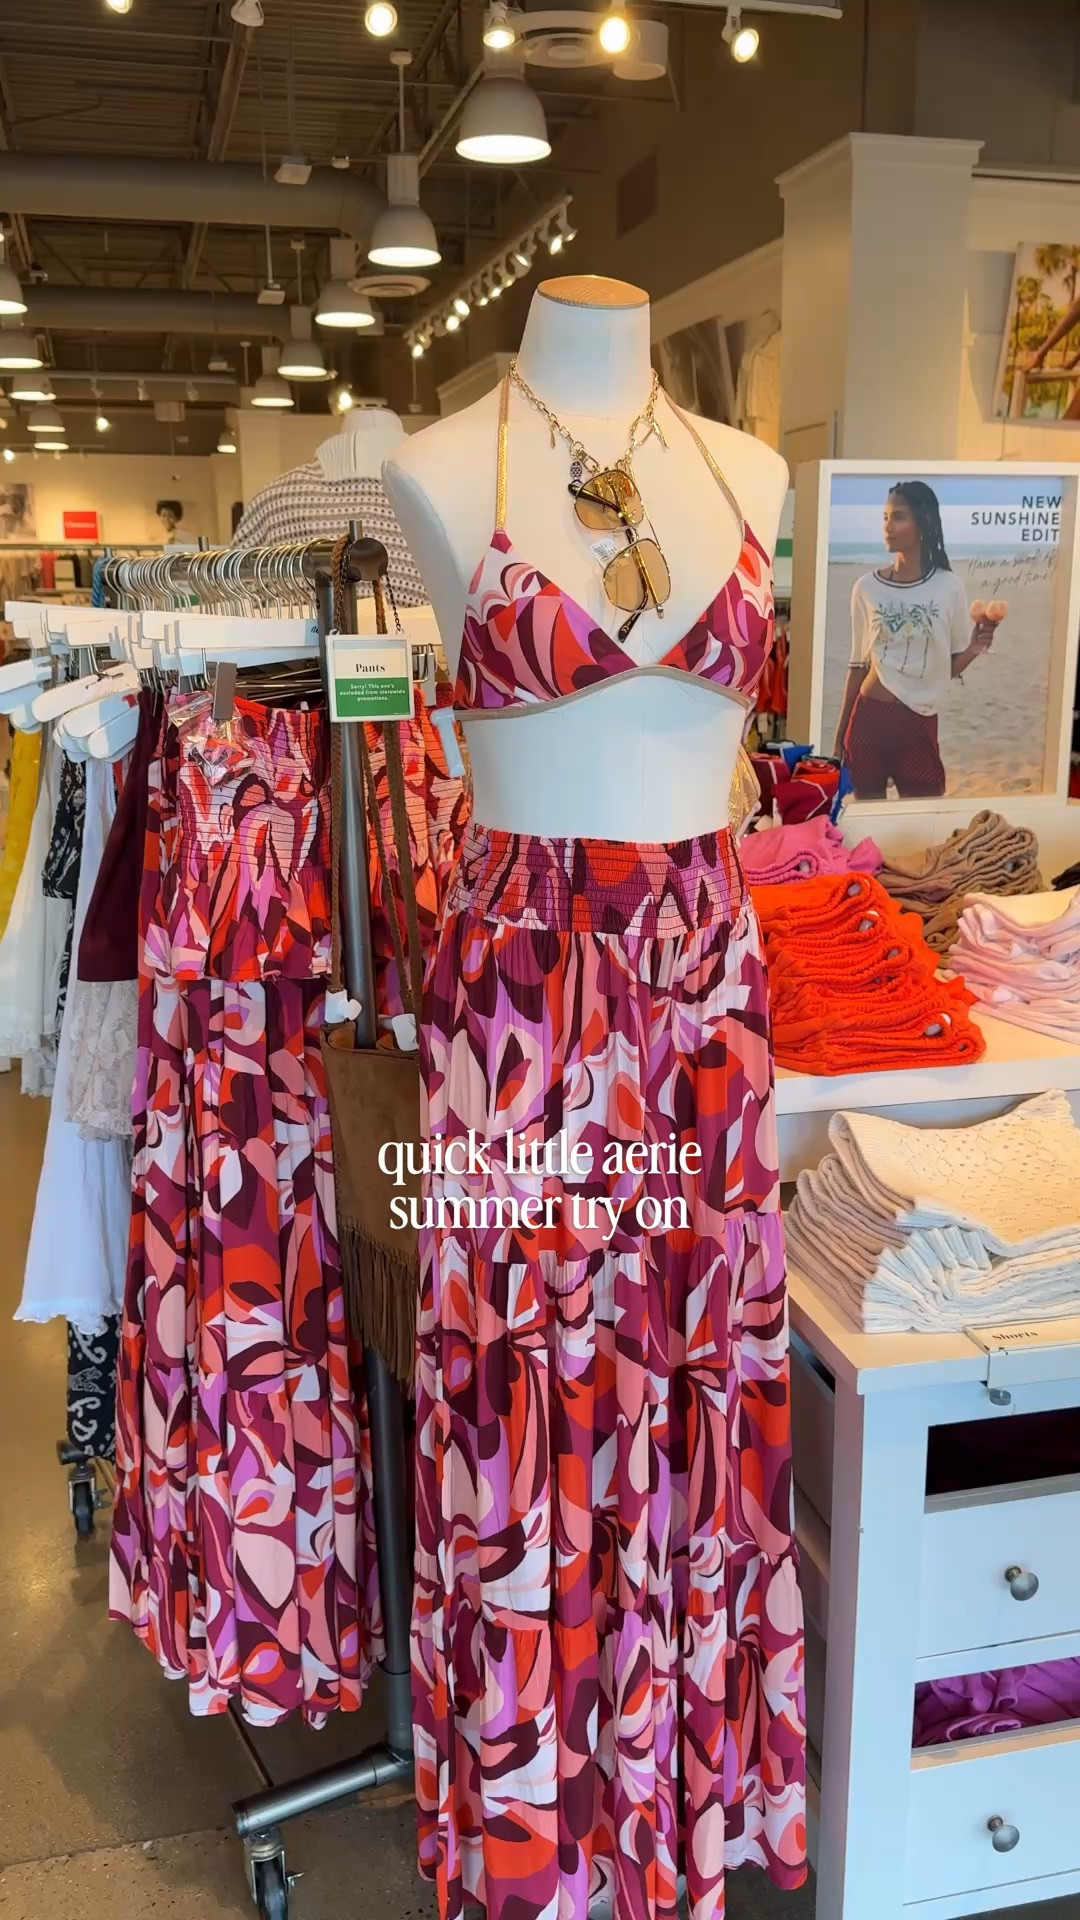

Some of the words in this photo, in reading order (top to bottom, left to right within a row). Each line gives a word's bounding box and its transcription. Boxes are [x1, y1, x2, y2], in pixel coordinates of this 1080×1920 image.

[1021, 496, 1062, 509] NEW
[971, 512, 1060, 525] SUNSHINE
[1021, 528, 1060, 542] EDIT
[355, 663, 386, 673] Pants
